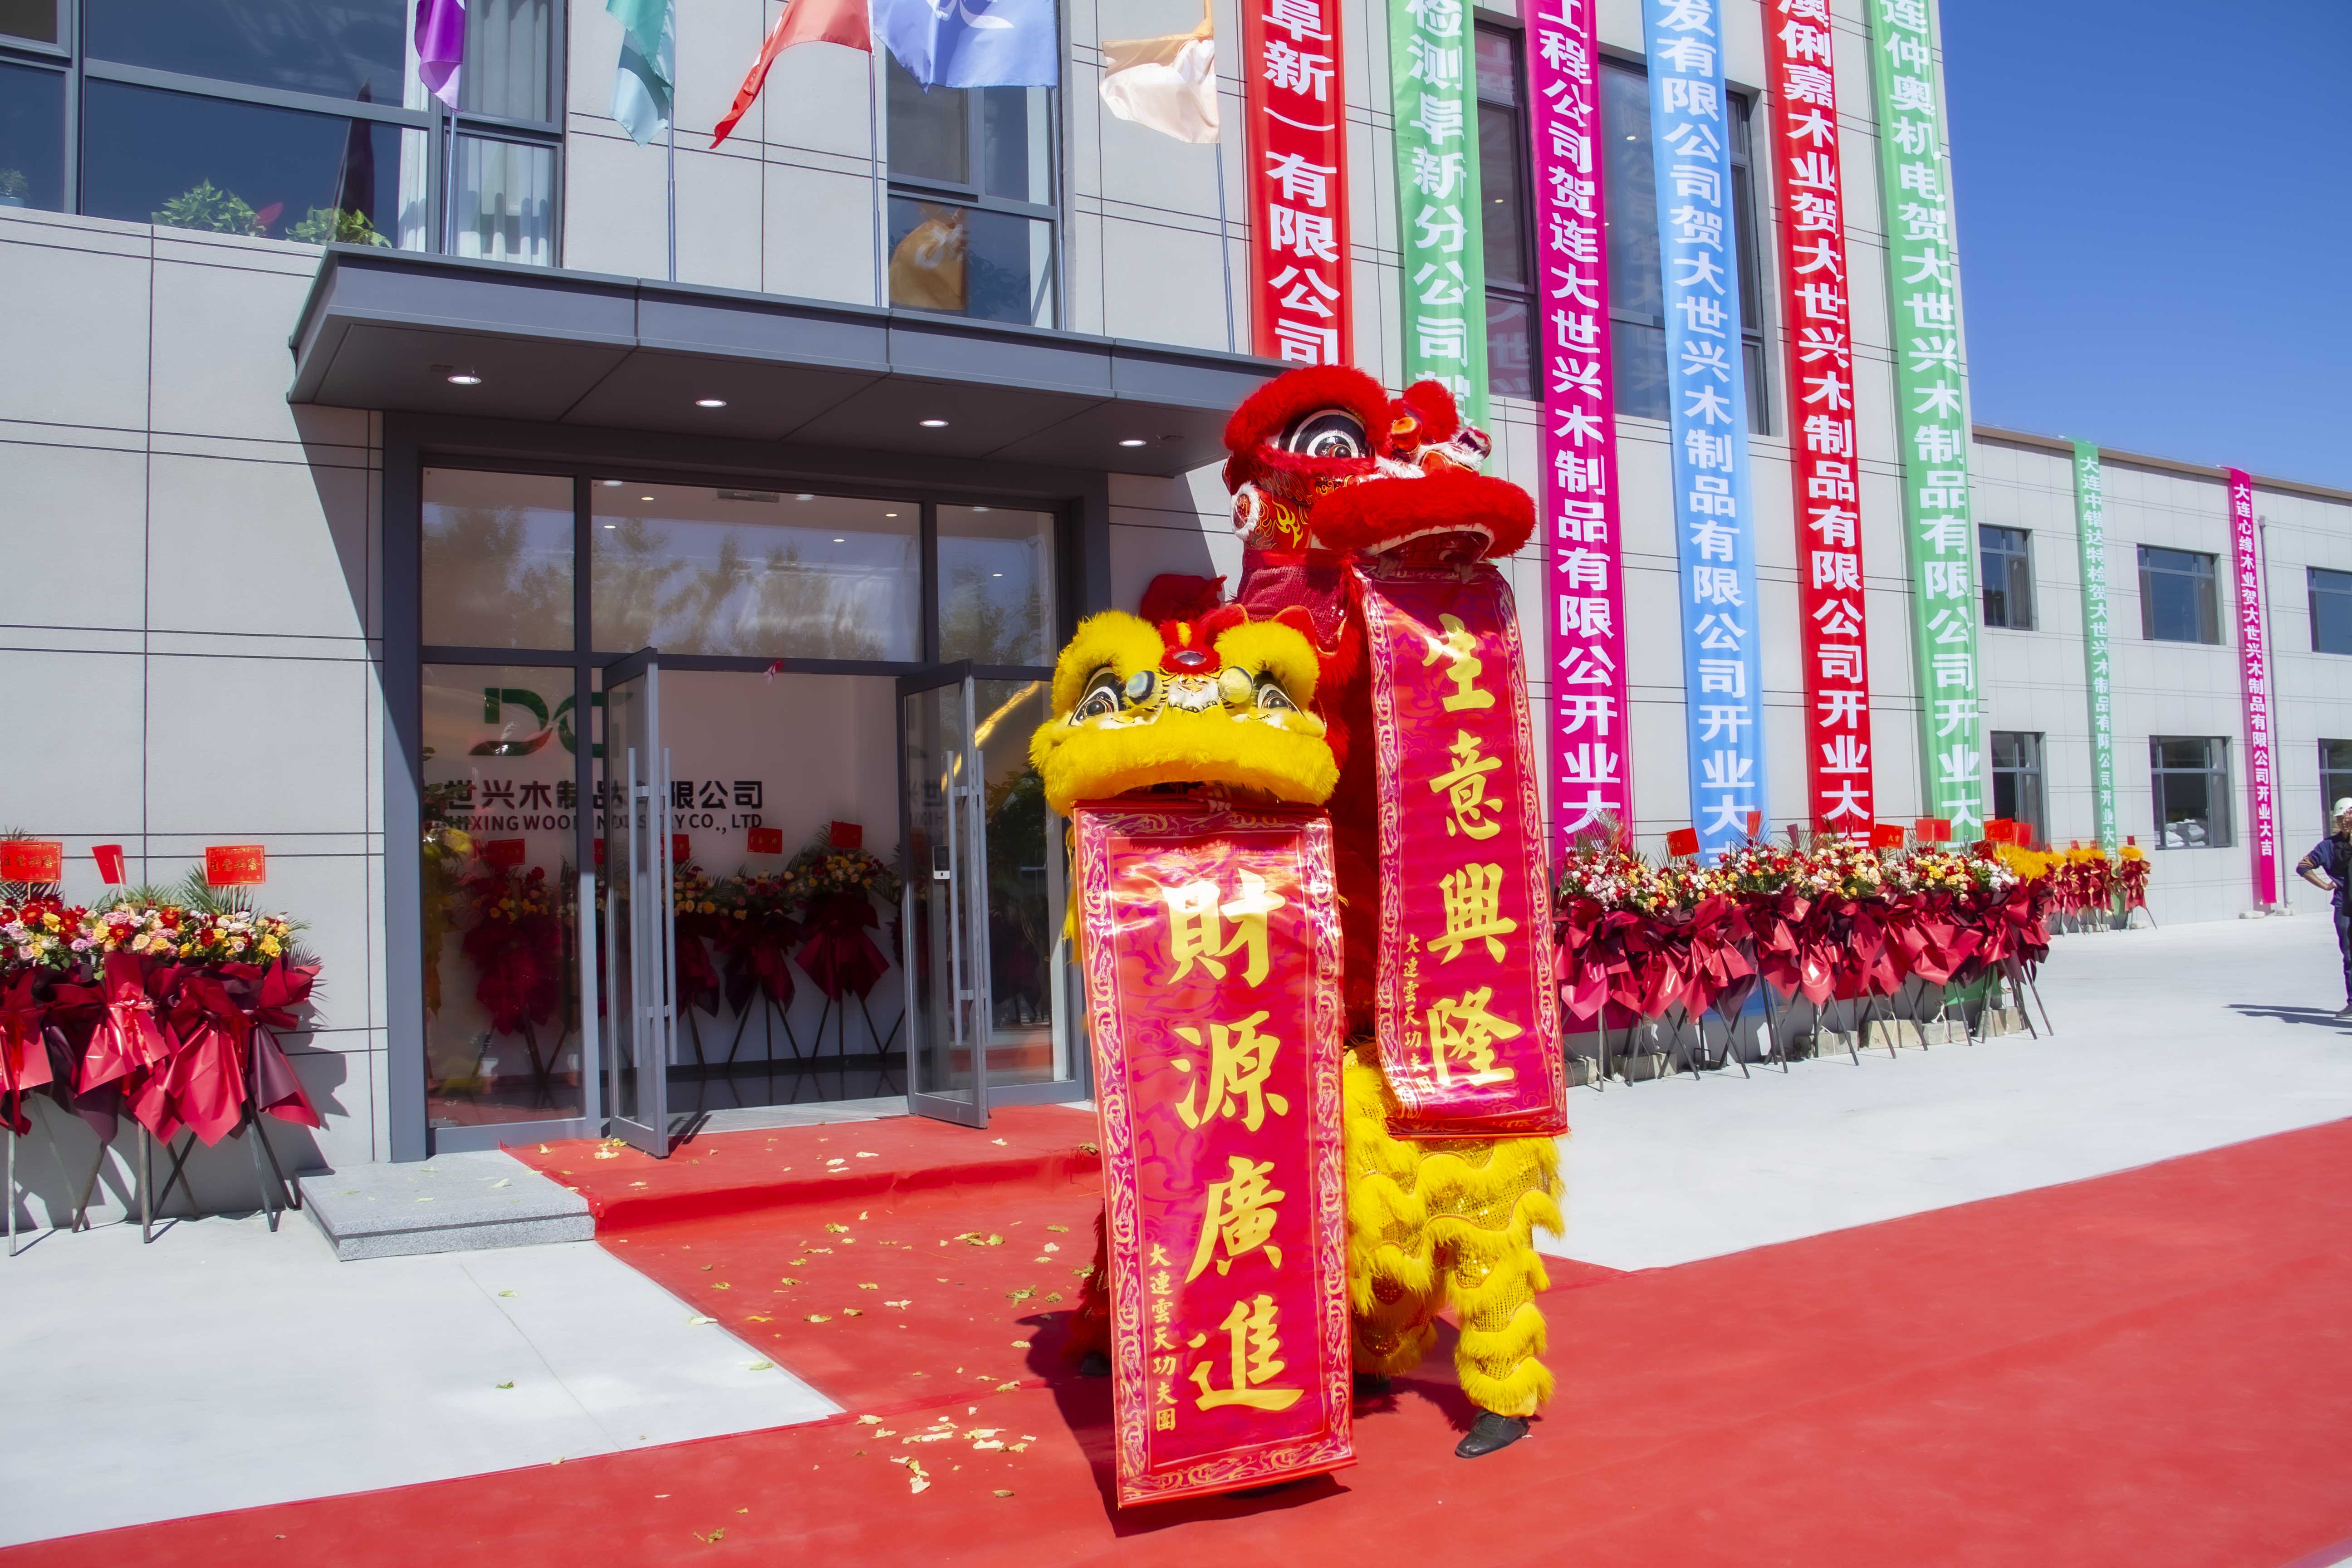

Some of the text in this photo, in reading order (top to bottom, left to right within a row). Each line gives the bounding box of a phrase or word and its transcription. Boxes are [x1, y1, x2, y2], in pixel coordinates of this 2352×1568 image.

[1404, 0, 1473, 426] 检测阜新分公司
[1538, 0, 1621, 852] 工程公司贺连大世兴木制品有限公开业大
[1880, 0, 1981, 857] 连仲奥机电贺大世兴木制品有限公司开业大
[523, 815, 577, 830] WOO
[732, 814, 762, 828] LTD
[1422, 613, 1523, 1088] 生意興隆
[2234, 484, 2272, 856] 大连心缘木业贺大世兴木制品有限公司开业大吉
[1161, 867, 1305, 1412] 財源廣進
